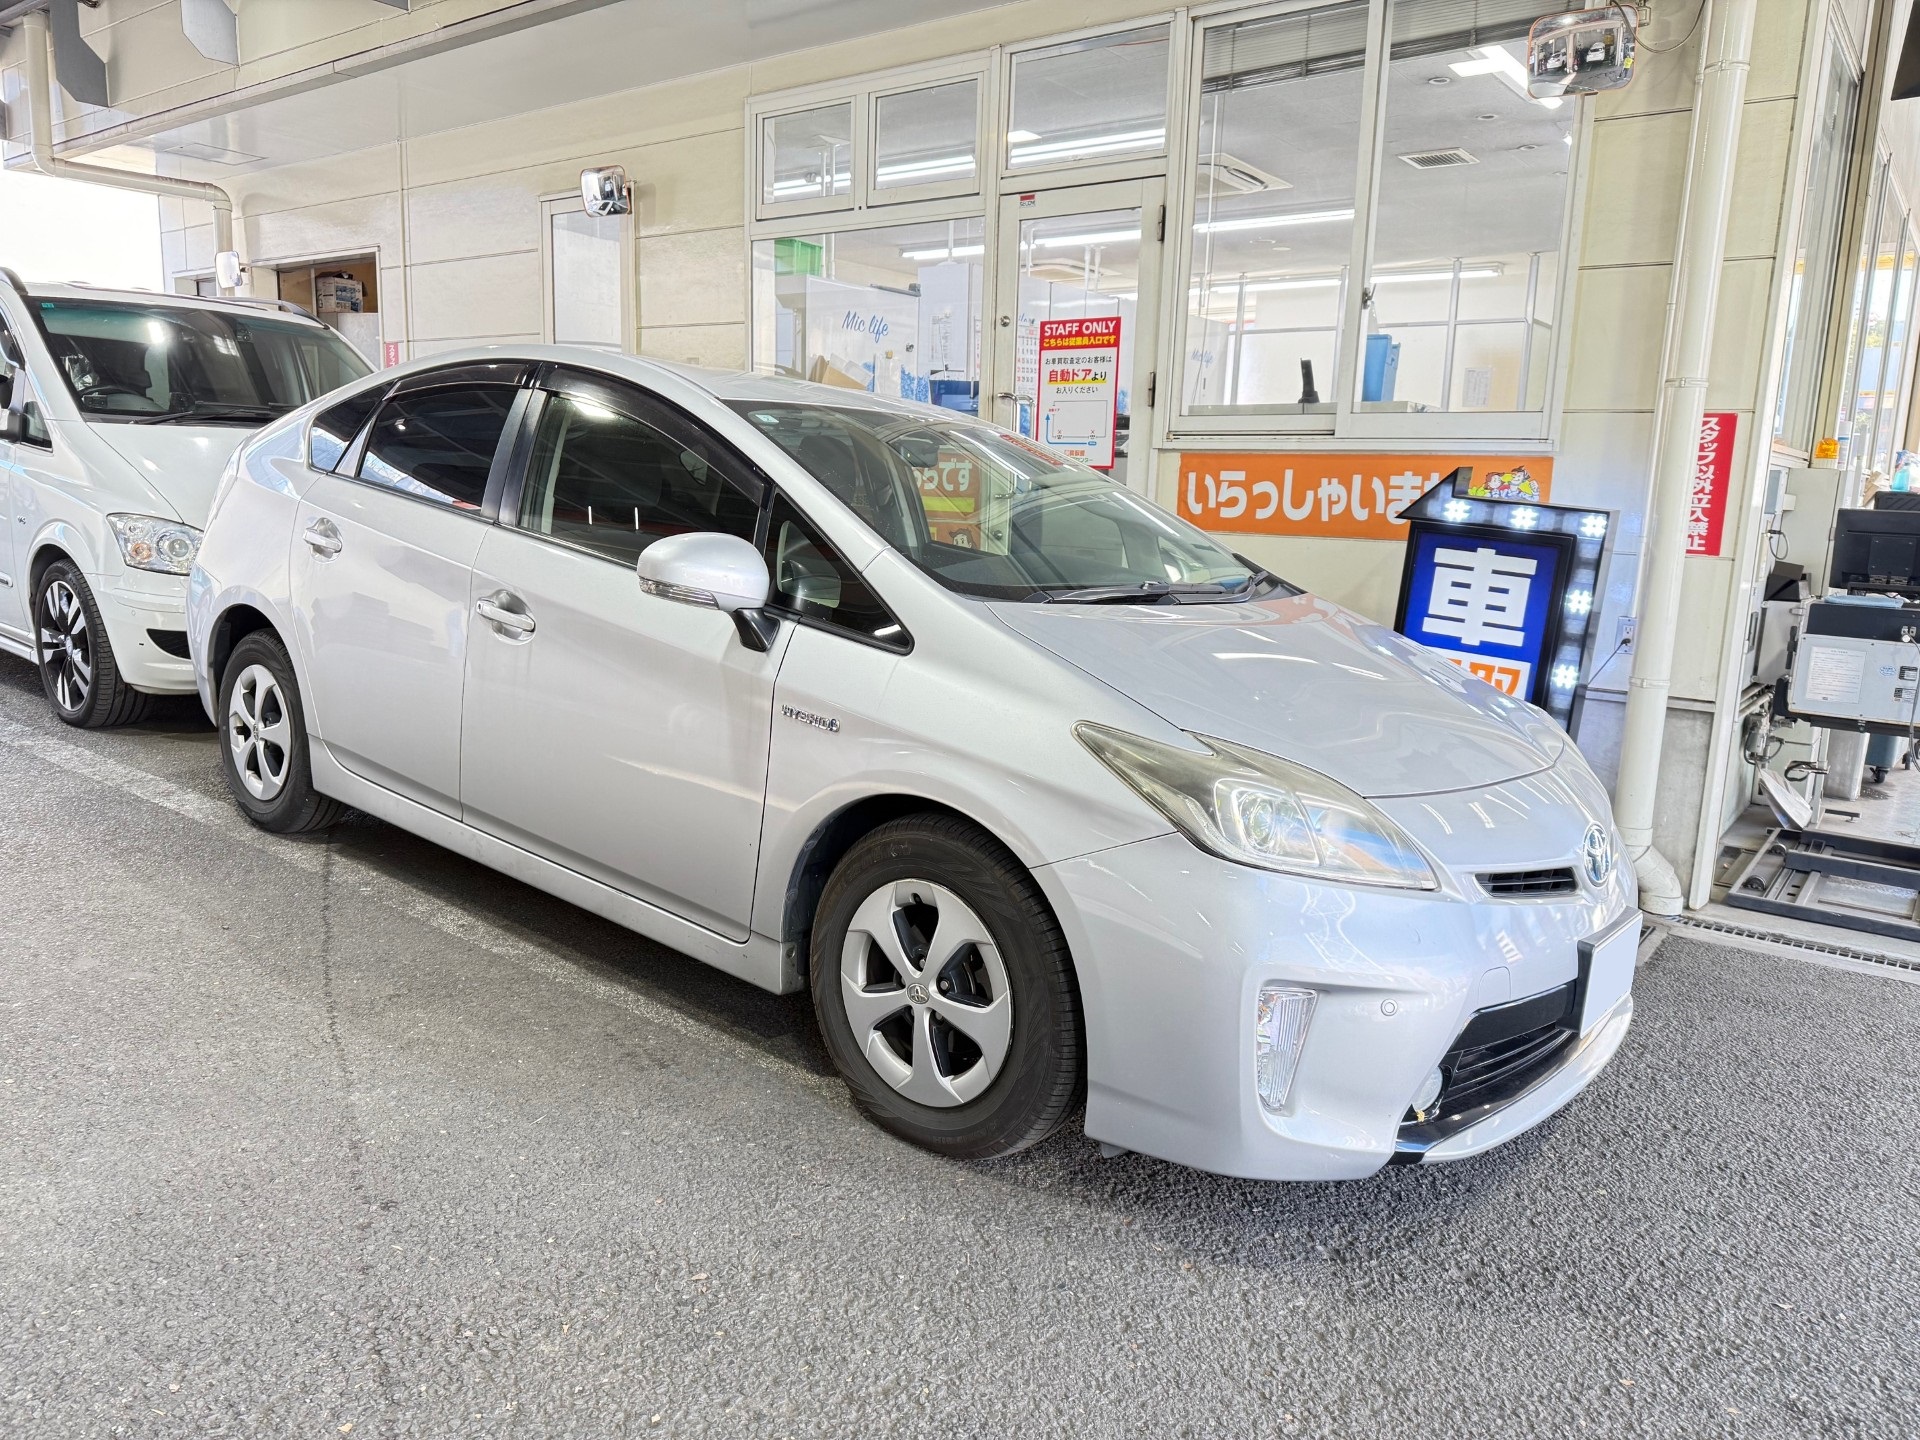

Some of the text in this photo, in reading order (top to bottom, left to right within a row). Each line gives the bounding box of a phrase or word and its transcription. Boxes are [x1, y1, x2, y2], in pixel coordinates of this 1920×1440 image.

[842, 310, 889, 343] Mic life
[1044, 320, 1116, 336] STAFF ONLY
[1043, 335, 1116, 347] こちらは従業員入口です
[1045, 356, 1112, 365] お車買取査定のお客様は
[1049, 368, 1107, 382] 自動ドアより
[1056, 386, 1099, 394] お入りください
[1687, 417, 1721, 551] スタッフ以外立入禁止
[1422, 547, 1538, 647] 車
